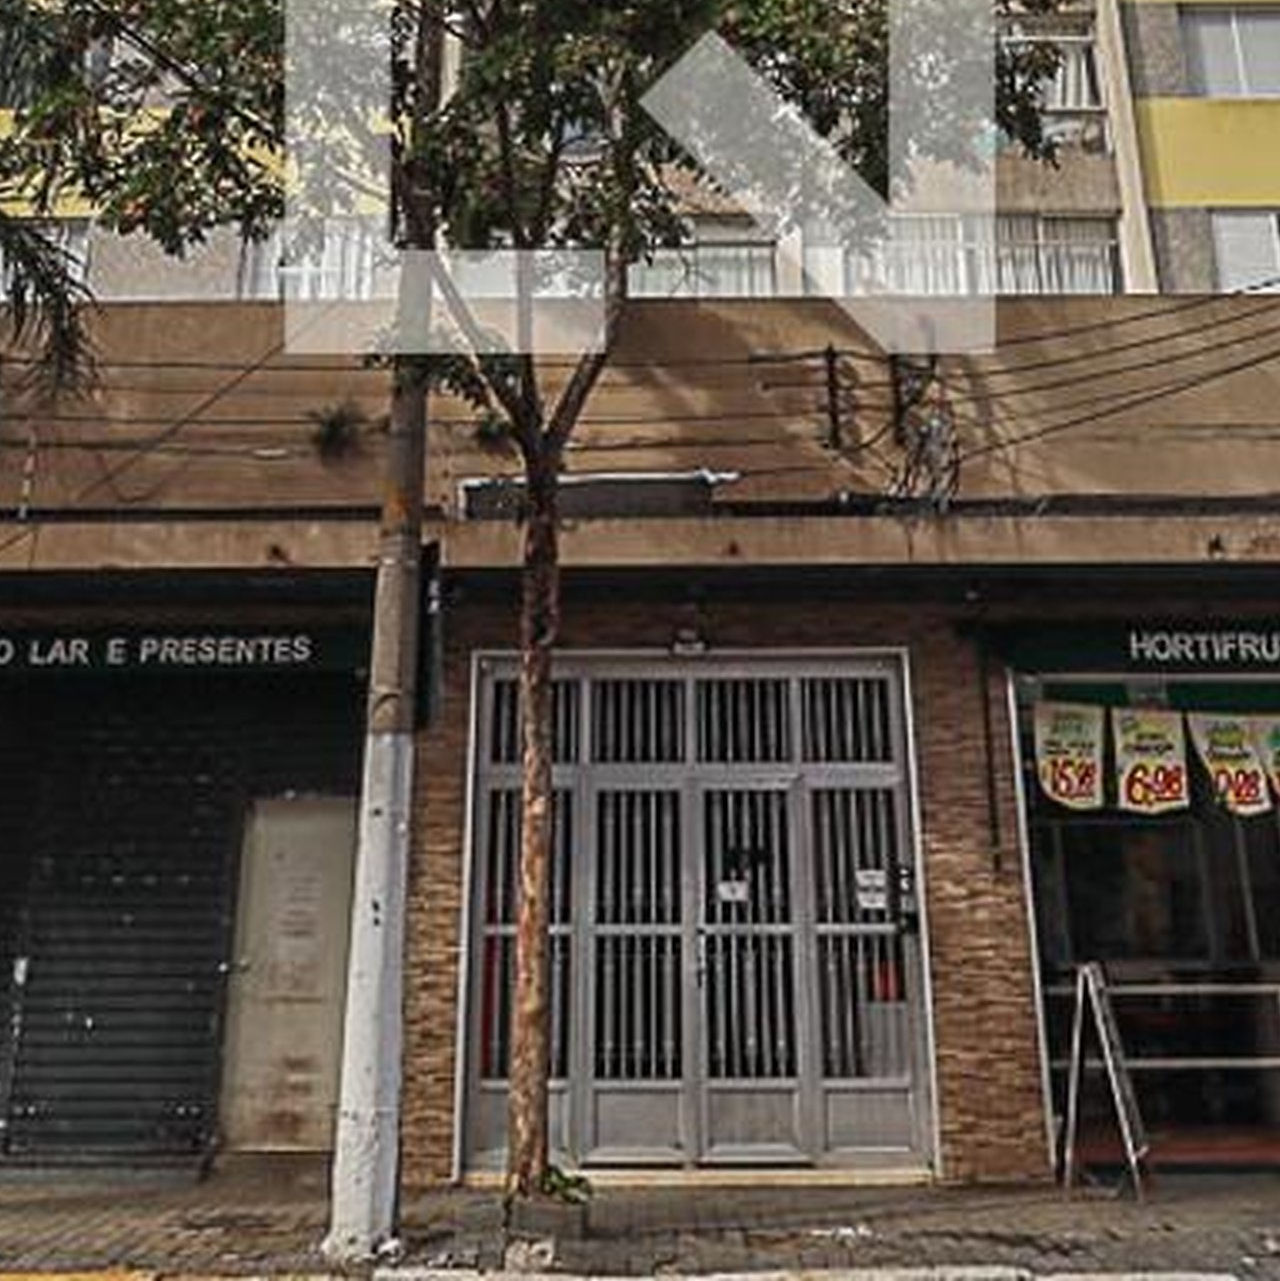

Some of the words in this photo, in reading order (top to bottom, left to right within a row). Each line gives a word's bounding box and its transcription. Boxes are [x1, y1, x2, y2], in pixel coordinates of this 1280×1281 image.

[28, 639, 89, 665] LAR
[107, 639, 125, 664] E
[139, 636, 311, 664] PRESENTES
